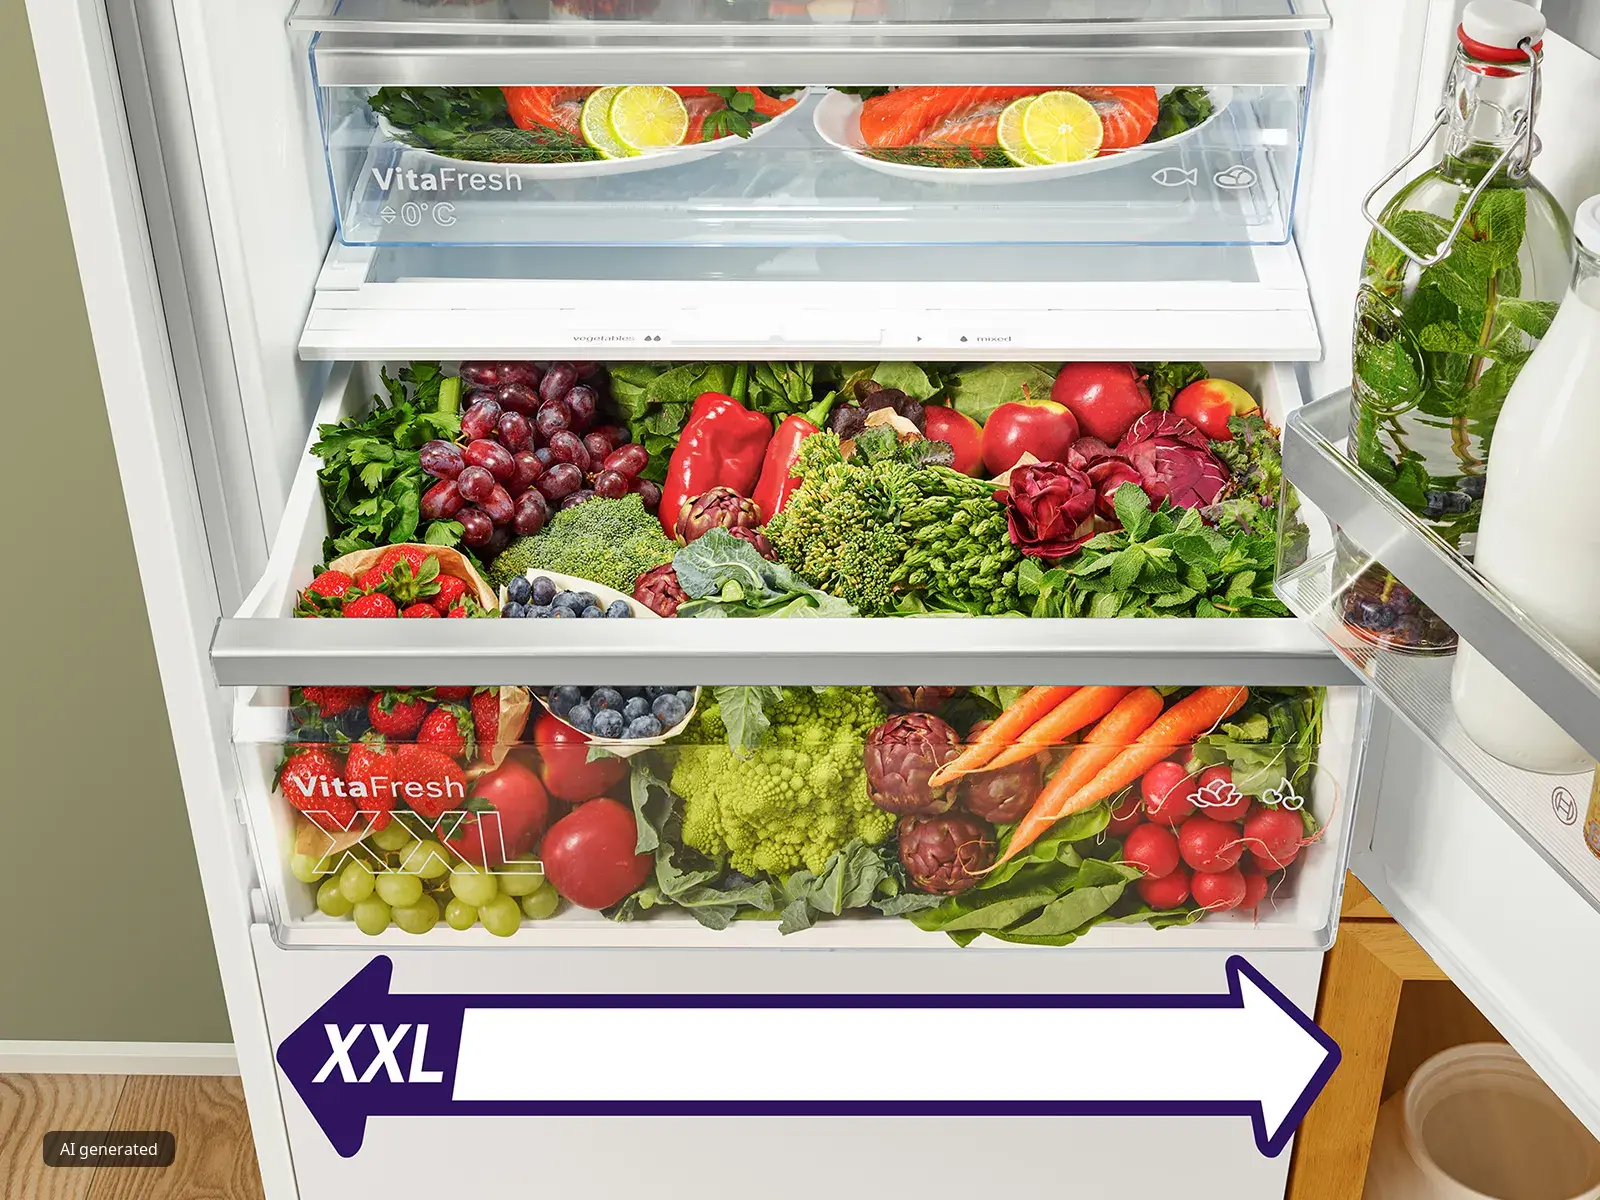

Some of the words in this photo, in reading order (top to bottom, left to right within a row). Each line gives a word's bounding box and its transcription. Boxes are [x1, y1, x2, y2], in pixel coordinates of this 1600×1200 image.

[372, 166, 522, 191] VitaFresh
[292, 775, 465, 798] VitaFresh
[301, 810, 545, 875] XXL
